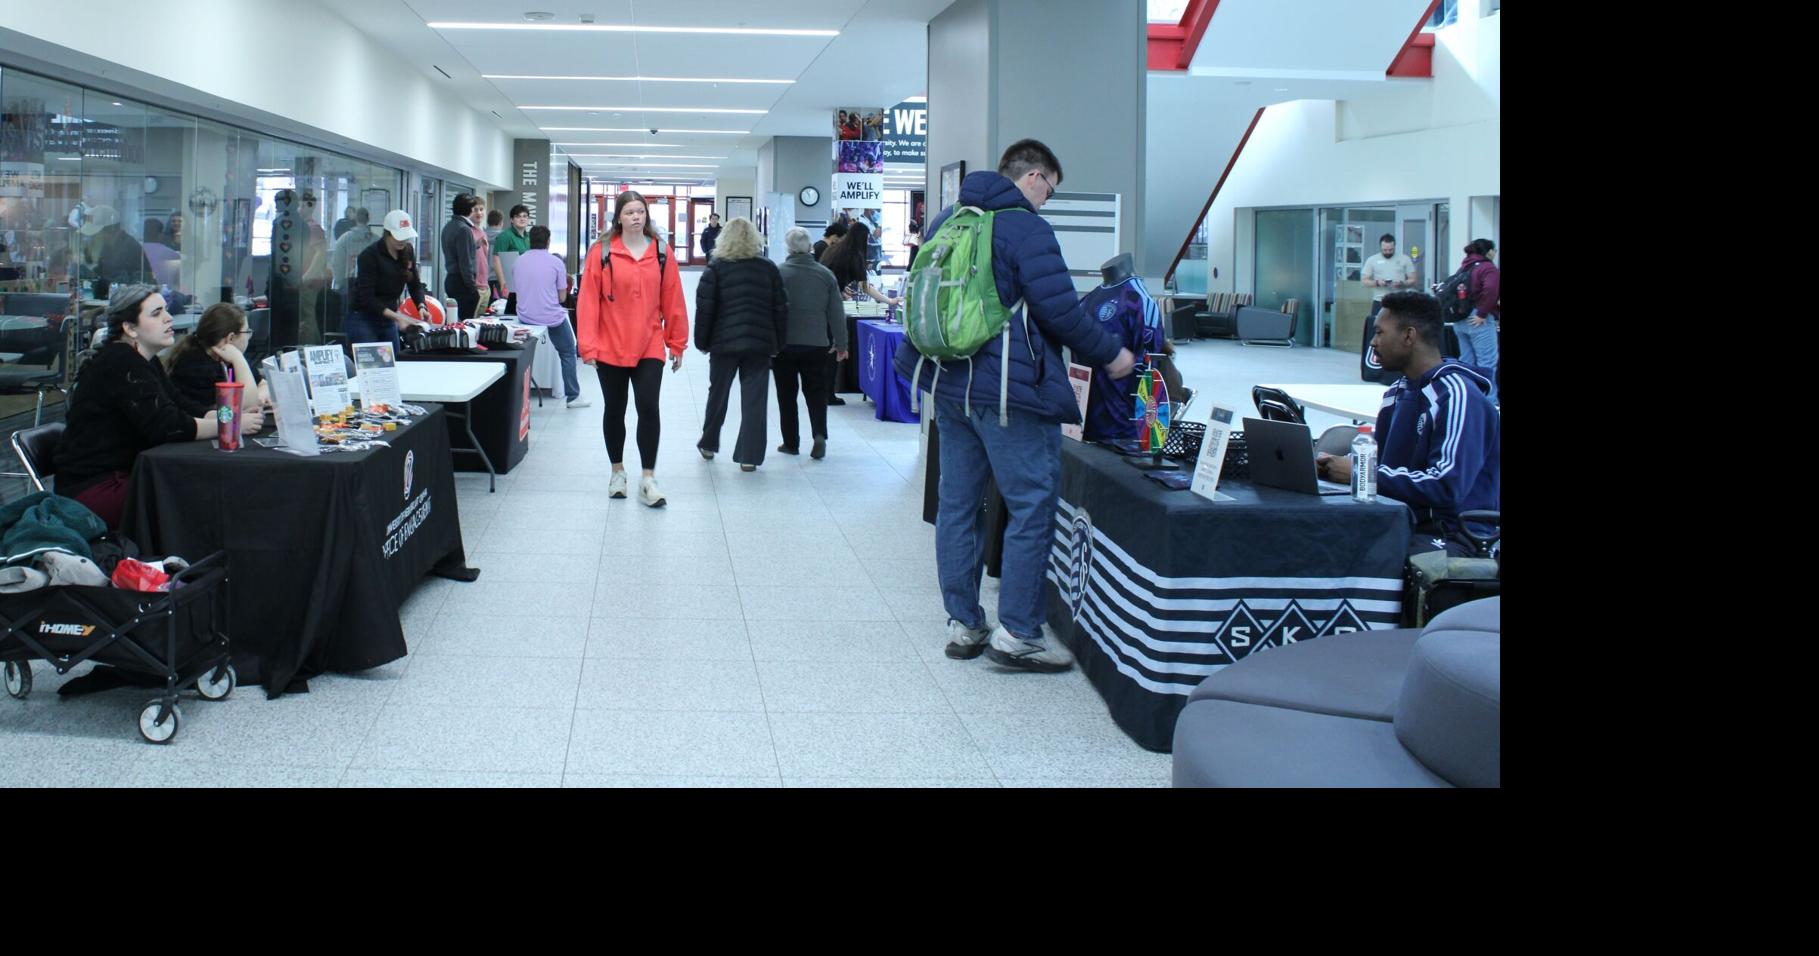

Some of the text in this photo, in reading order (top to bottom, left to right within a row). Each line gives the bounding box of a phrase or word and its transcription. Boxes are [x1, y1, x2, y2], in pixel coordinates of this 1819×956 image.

[895, 109, 926, 135] WE
[522, 161, 537, 186] THE
[846, 181, 874, 191] WE'LL
[840, 191, 880, 200] AMPLIFY
[1359, 453, 1368, 492] BODYARMOR
